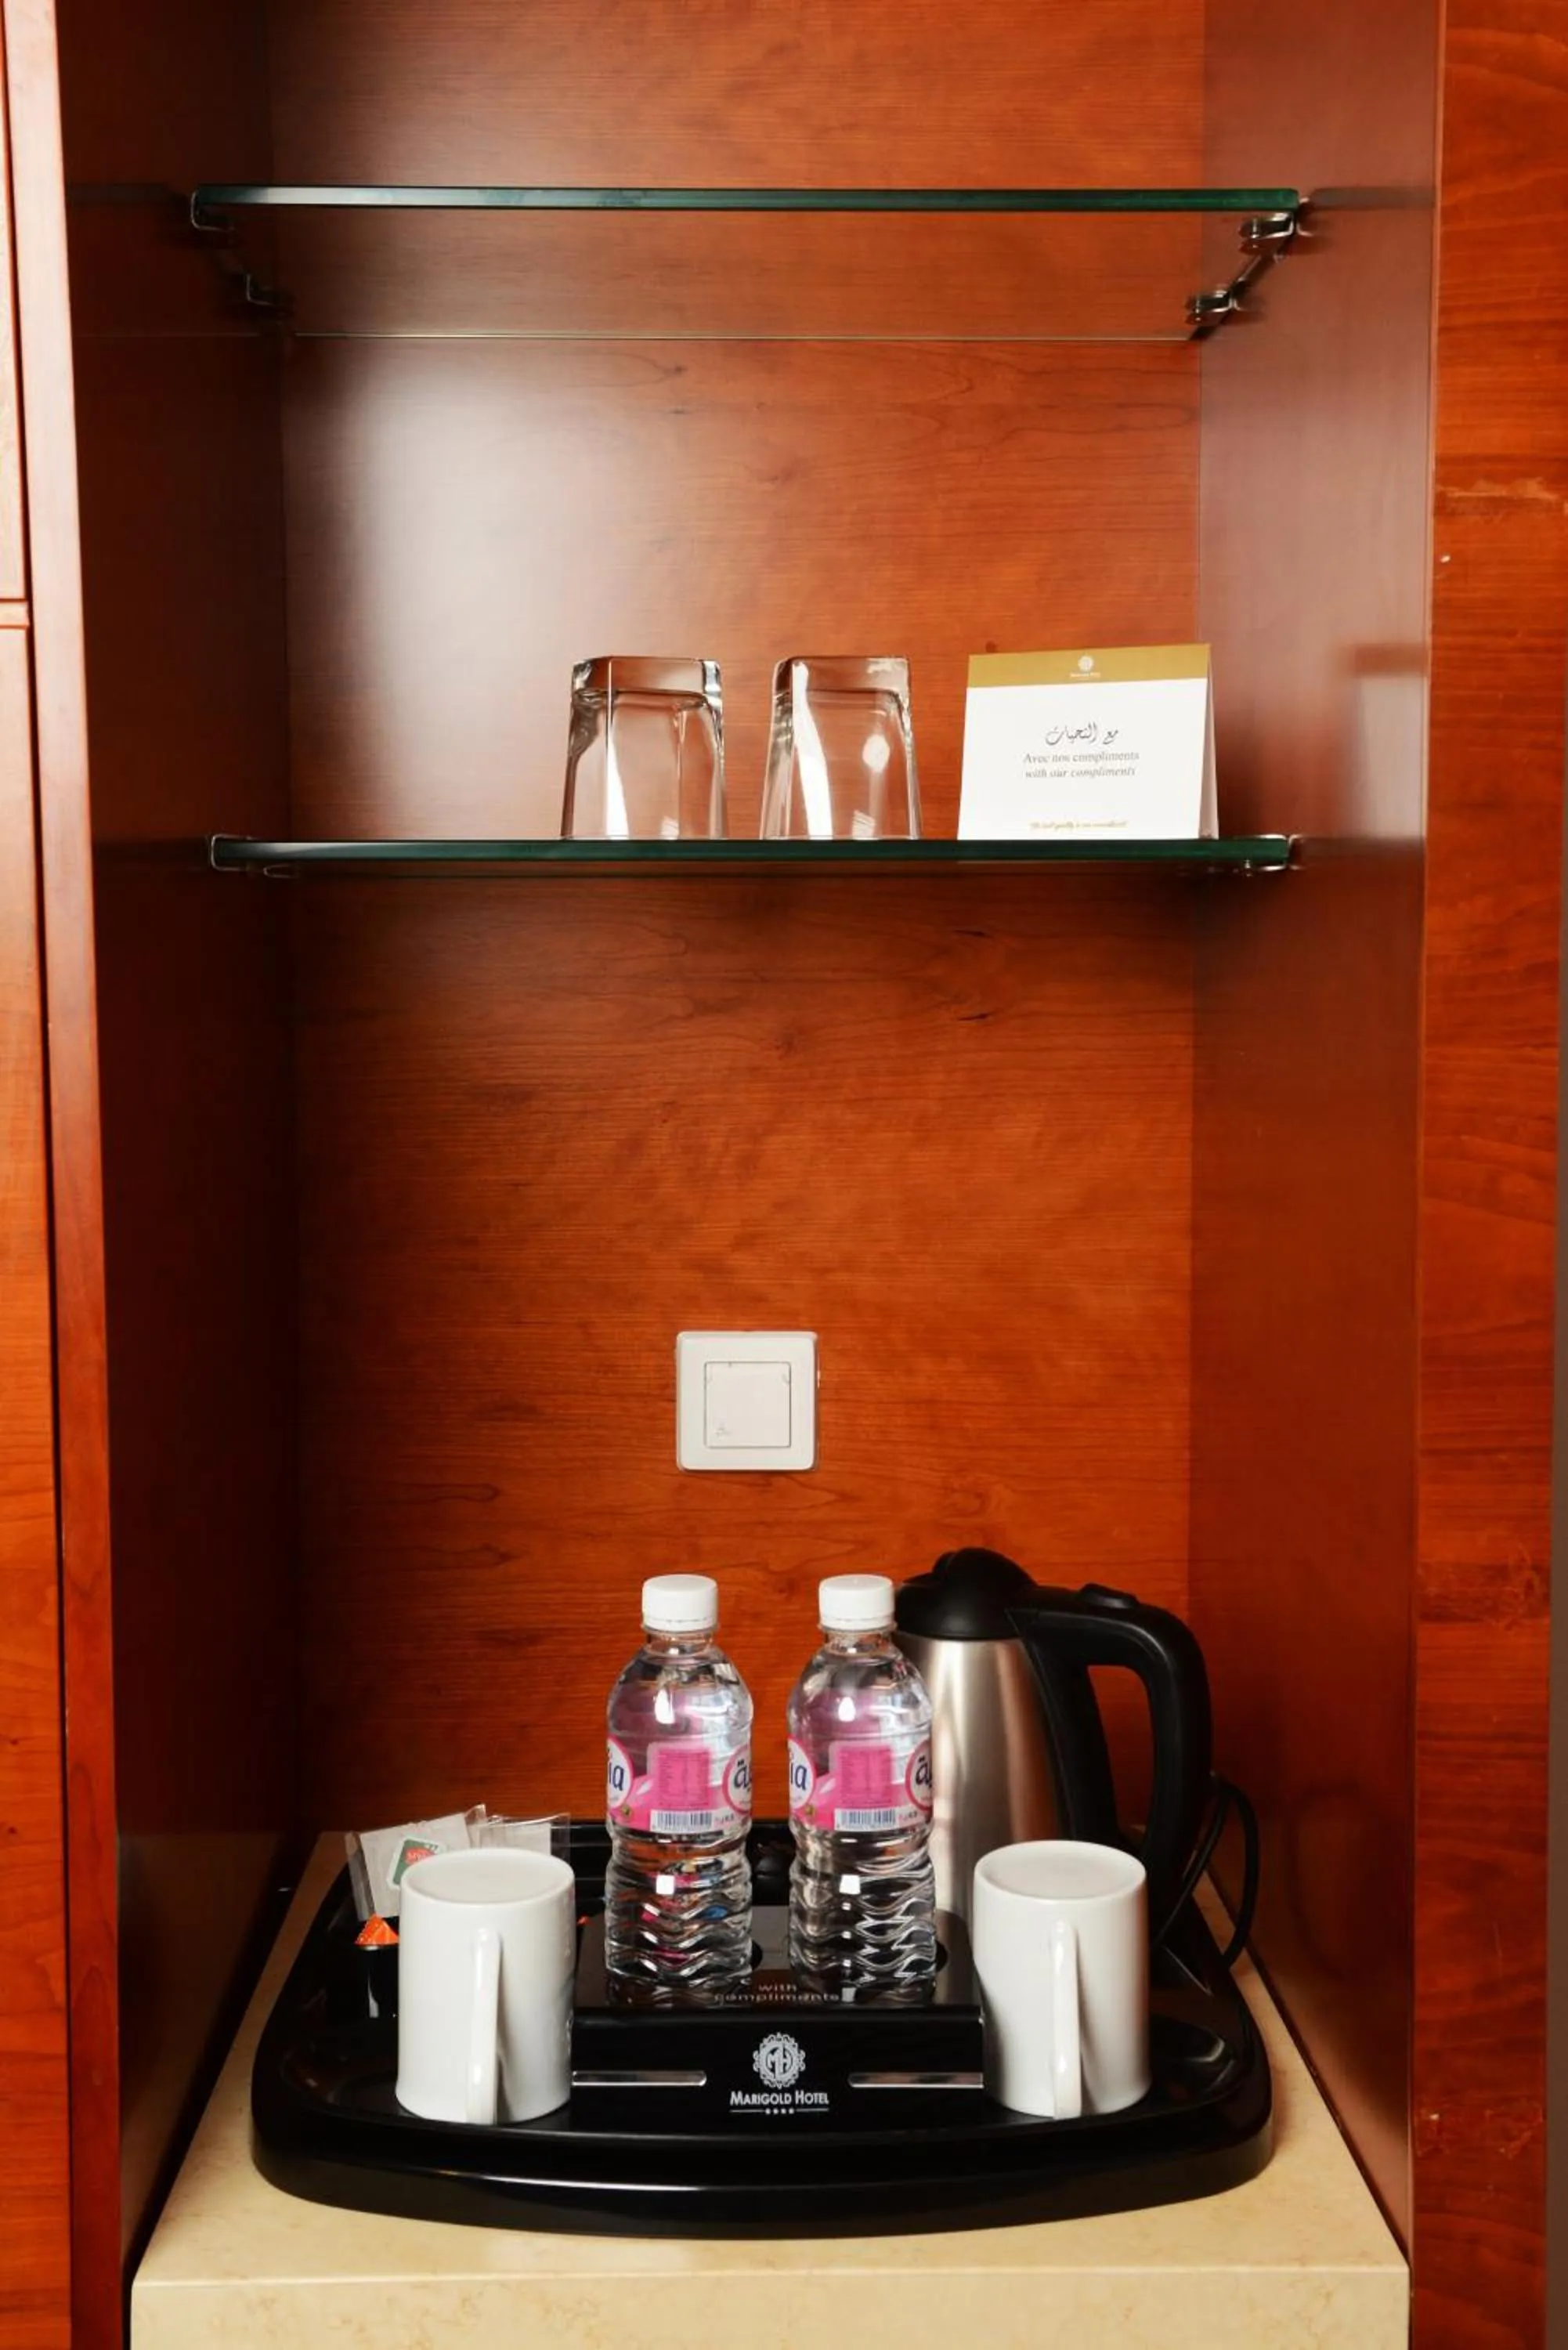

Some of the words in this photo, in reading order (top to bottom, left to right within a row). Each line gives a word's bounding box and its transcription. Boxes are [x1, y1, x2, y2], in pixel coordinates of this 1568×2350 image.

[1024, 753, 1048, 763] Avec
[1052, 753, 1070, 762] nos
[1072, 750, 1140, 764] compliments
[1025, 767, 1047, 778] with
[1050, 768, 1069, 778] our
[1071, 766, 1136, 779] compliments
[729, 2090, 792, 2106] MARIGOLD
[795, 2089, 829, 2105] HOTEL
